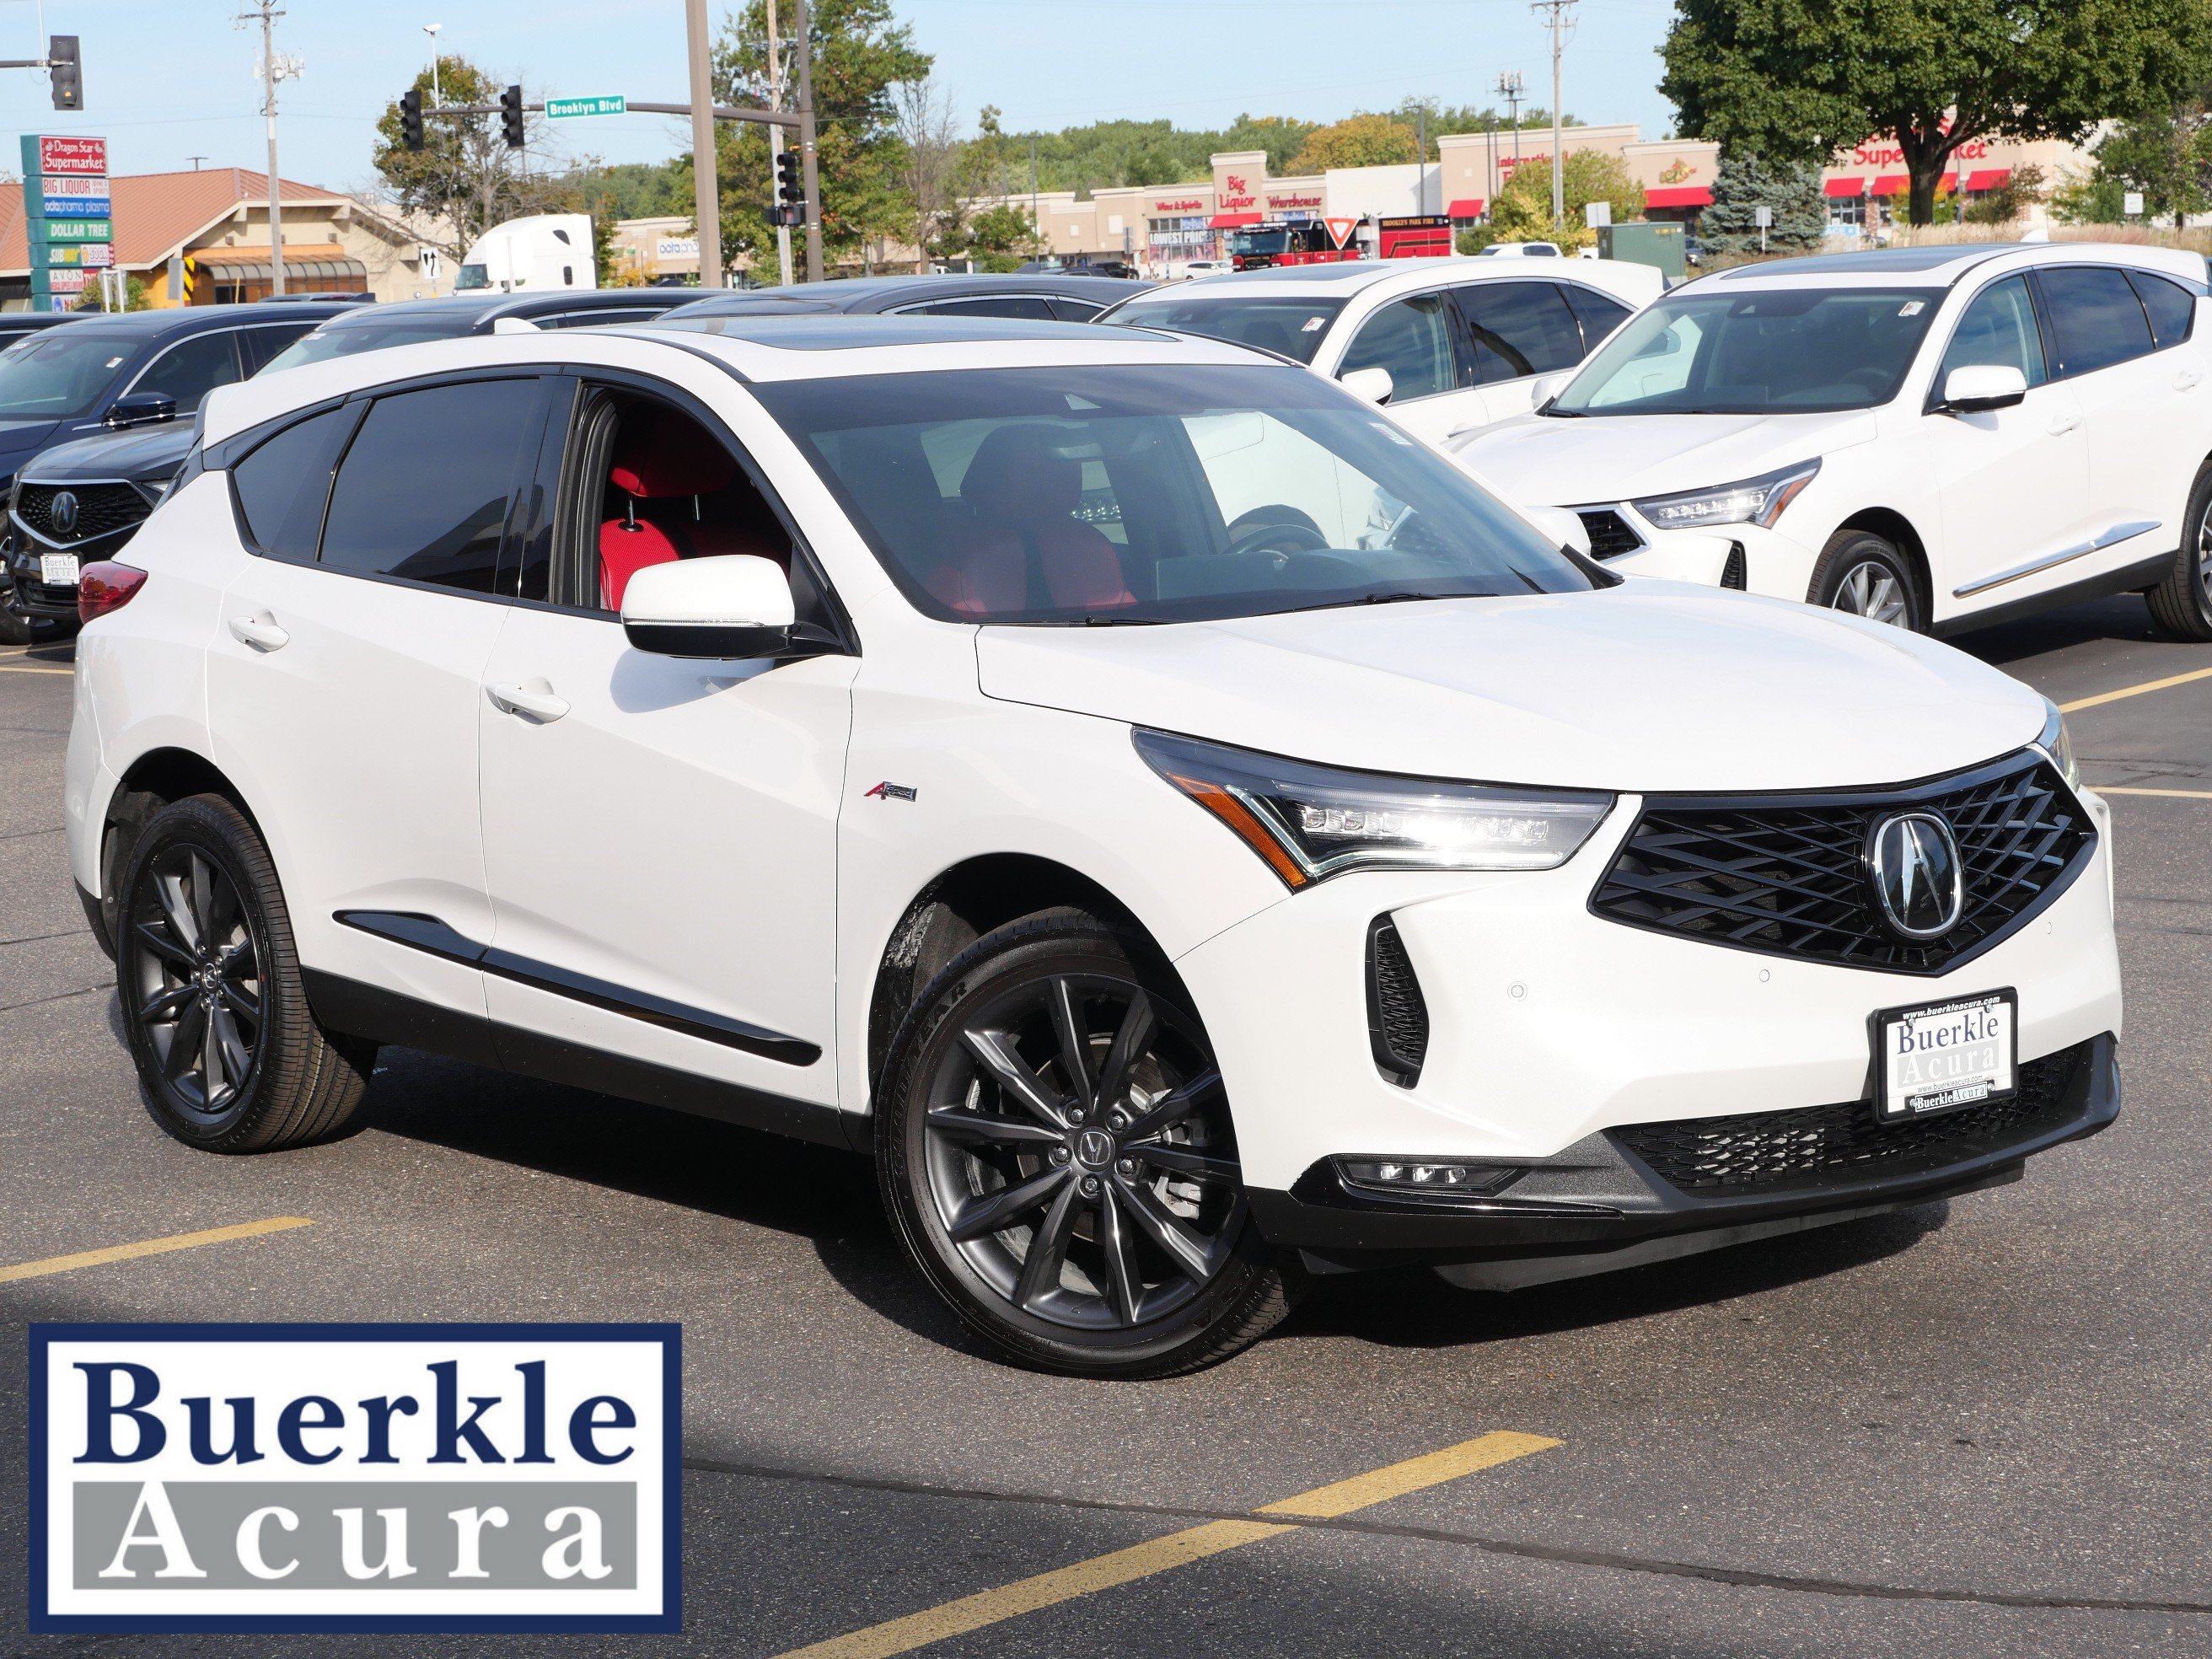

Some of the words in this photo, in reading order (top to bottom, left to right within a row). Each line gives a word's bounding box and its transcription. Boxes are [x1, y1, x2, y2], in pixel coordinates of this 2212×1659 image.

[550, 102, 595, 115] Brooklyn
[599, 99, 622, 112] Blvd
[54, 140, 78, 154] Dragon
[79, 141, 94, 153] Star
[46, 153, 104, 171] Supermarket
[43, 179, 57, 194] BIG
[61, 180, 91, 195] LIQUOR
[1227, 175, 1246, 195] Big
[45, 200, 84, 213] octapharma
[85, 201, 110, 214] plasma
[1156, 201, 1173, 211] Wine
[1181, 200, 1202, 213] Spirits
[1219, 194, 1256, 212] Liquor
[1267, 192, 1322, 209] Warehouse
[51, 223, 85, 237] DOLLAR
[88, 223, 109, 237] TREE
[1149, 231, 1183, 245] LOWEST
[1184, 229, 1215, 244] PRICES
[49, 247, 80, 264] SUBWAY
[53, 269, 82, 281] AVON
[45, 557, 75, 566] Buerkle
[47, 567, 74, 577] Acura
[1903, 996, 2000, 1020] www.buerkleacura.com
[1897, 1011, 1999, 1055] Buerkle
[1902, 1047, 1995, 1085] Acura
[1917, 1075, 1984, 1093] www.buerkleacura.com
